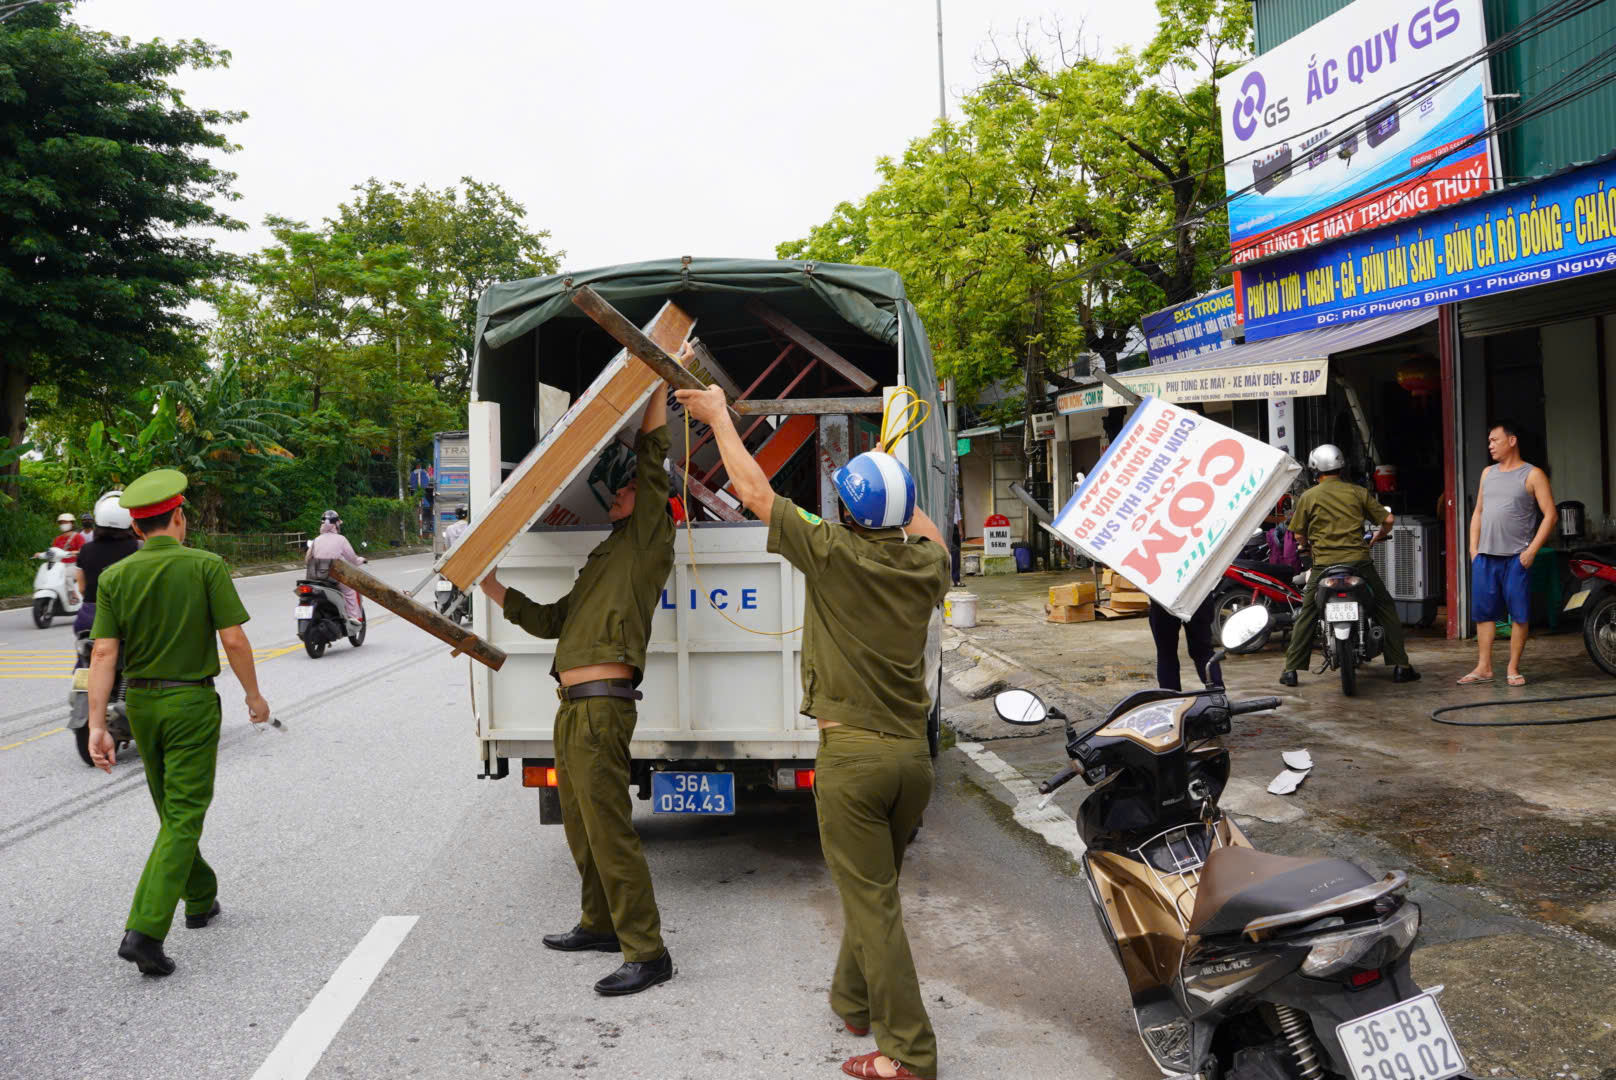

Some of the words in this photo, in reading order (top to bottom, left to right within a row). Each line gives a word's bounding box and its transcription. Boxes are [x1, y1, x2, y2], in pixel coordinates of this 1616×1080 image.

[1306, 53, 1338, 105] ẮC
[1347, 23, 1399, 84] QUY
[1408, 0, 1461, 49] GS
[1264, 97, 1290, 128] GS
[1262, 232, 1298, 256] TÙNG
[1302, 223, 1320, 246] XE
[1323, 210, 1355, 238] MÁY
[1359, 186, 1429, 225] TRƯỜNG
[1247, 272, 1266, 320] PHỞ
[1266, 271, 1279, 316] BÒ
[1306, 265, 1335, 307] NGAN
[1340, 253, 1356, 299] GÀ
[1361, 246, 1386, 295] BÚN
[1387, 234, 1408, 288] HẢI
[1410, 227, 1436, 284] SẢN
[1444, 222, 1473, 275] BÚN
[1475, 213, 1496, 268] CÁ
[1496, 207, 1518, 263] RÔ
[1519, 193, 1564, 258] ĐỒNG
[1574, 180, 1616, 245] CHÁO
[1194, 294, 1234, 316] TRỌNG
[1317, 312, 1339, 324] ĐC:
[1343, 306, 1367, 320] Phố
[1369, 296, 1421, 314] Phượng
[1424, 287, 1458, 303] Đình
[1464, 284, 1471, 294] 1
[1487, 268, 1551, 290] Phường
[1180, 377, 1198, 391] TÙNG
[1200, 379, 1208, 390] XE
[1233, 376, 1242, 388] XE
[1244, 372, 1261, 387] MÁY
[1264, 371, 1282, 388] ĐIỆN
[1290, 371, 1300, 384] XE
[1303, 369, 1321, 386] ĐẠP
[1145, 409, 1176, 445] CƠM
[1164, 418, 1196, 453] CƠM
[1116, 446, 1152, 486] RANG
[1135, 454, 1171, 494] RANG
[1092, 486, 1122, 517] DƯA
[1115, 494, 1142, 520] HẢI
[1121, 438, 1245, 585] CƠM
[1131, 456, 1191, 532] NÓNG
[1074, 518, 1097, 539] BÒ
[1090, 520, 1121, 550] SẢN
[675, 775, 710, 793] 36A
[661, 794, 726, 812] 034.43
[1354, 1005, 1432, 1057] 36-B3
